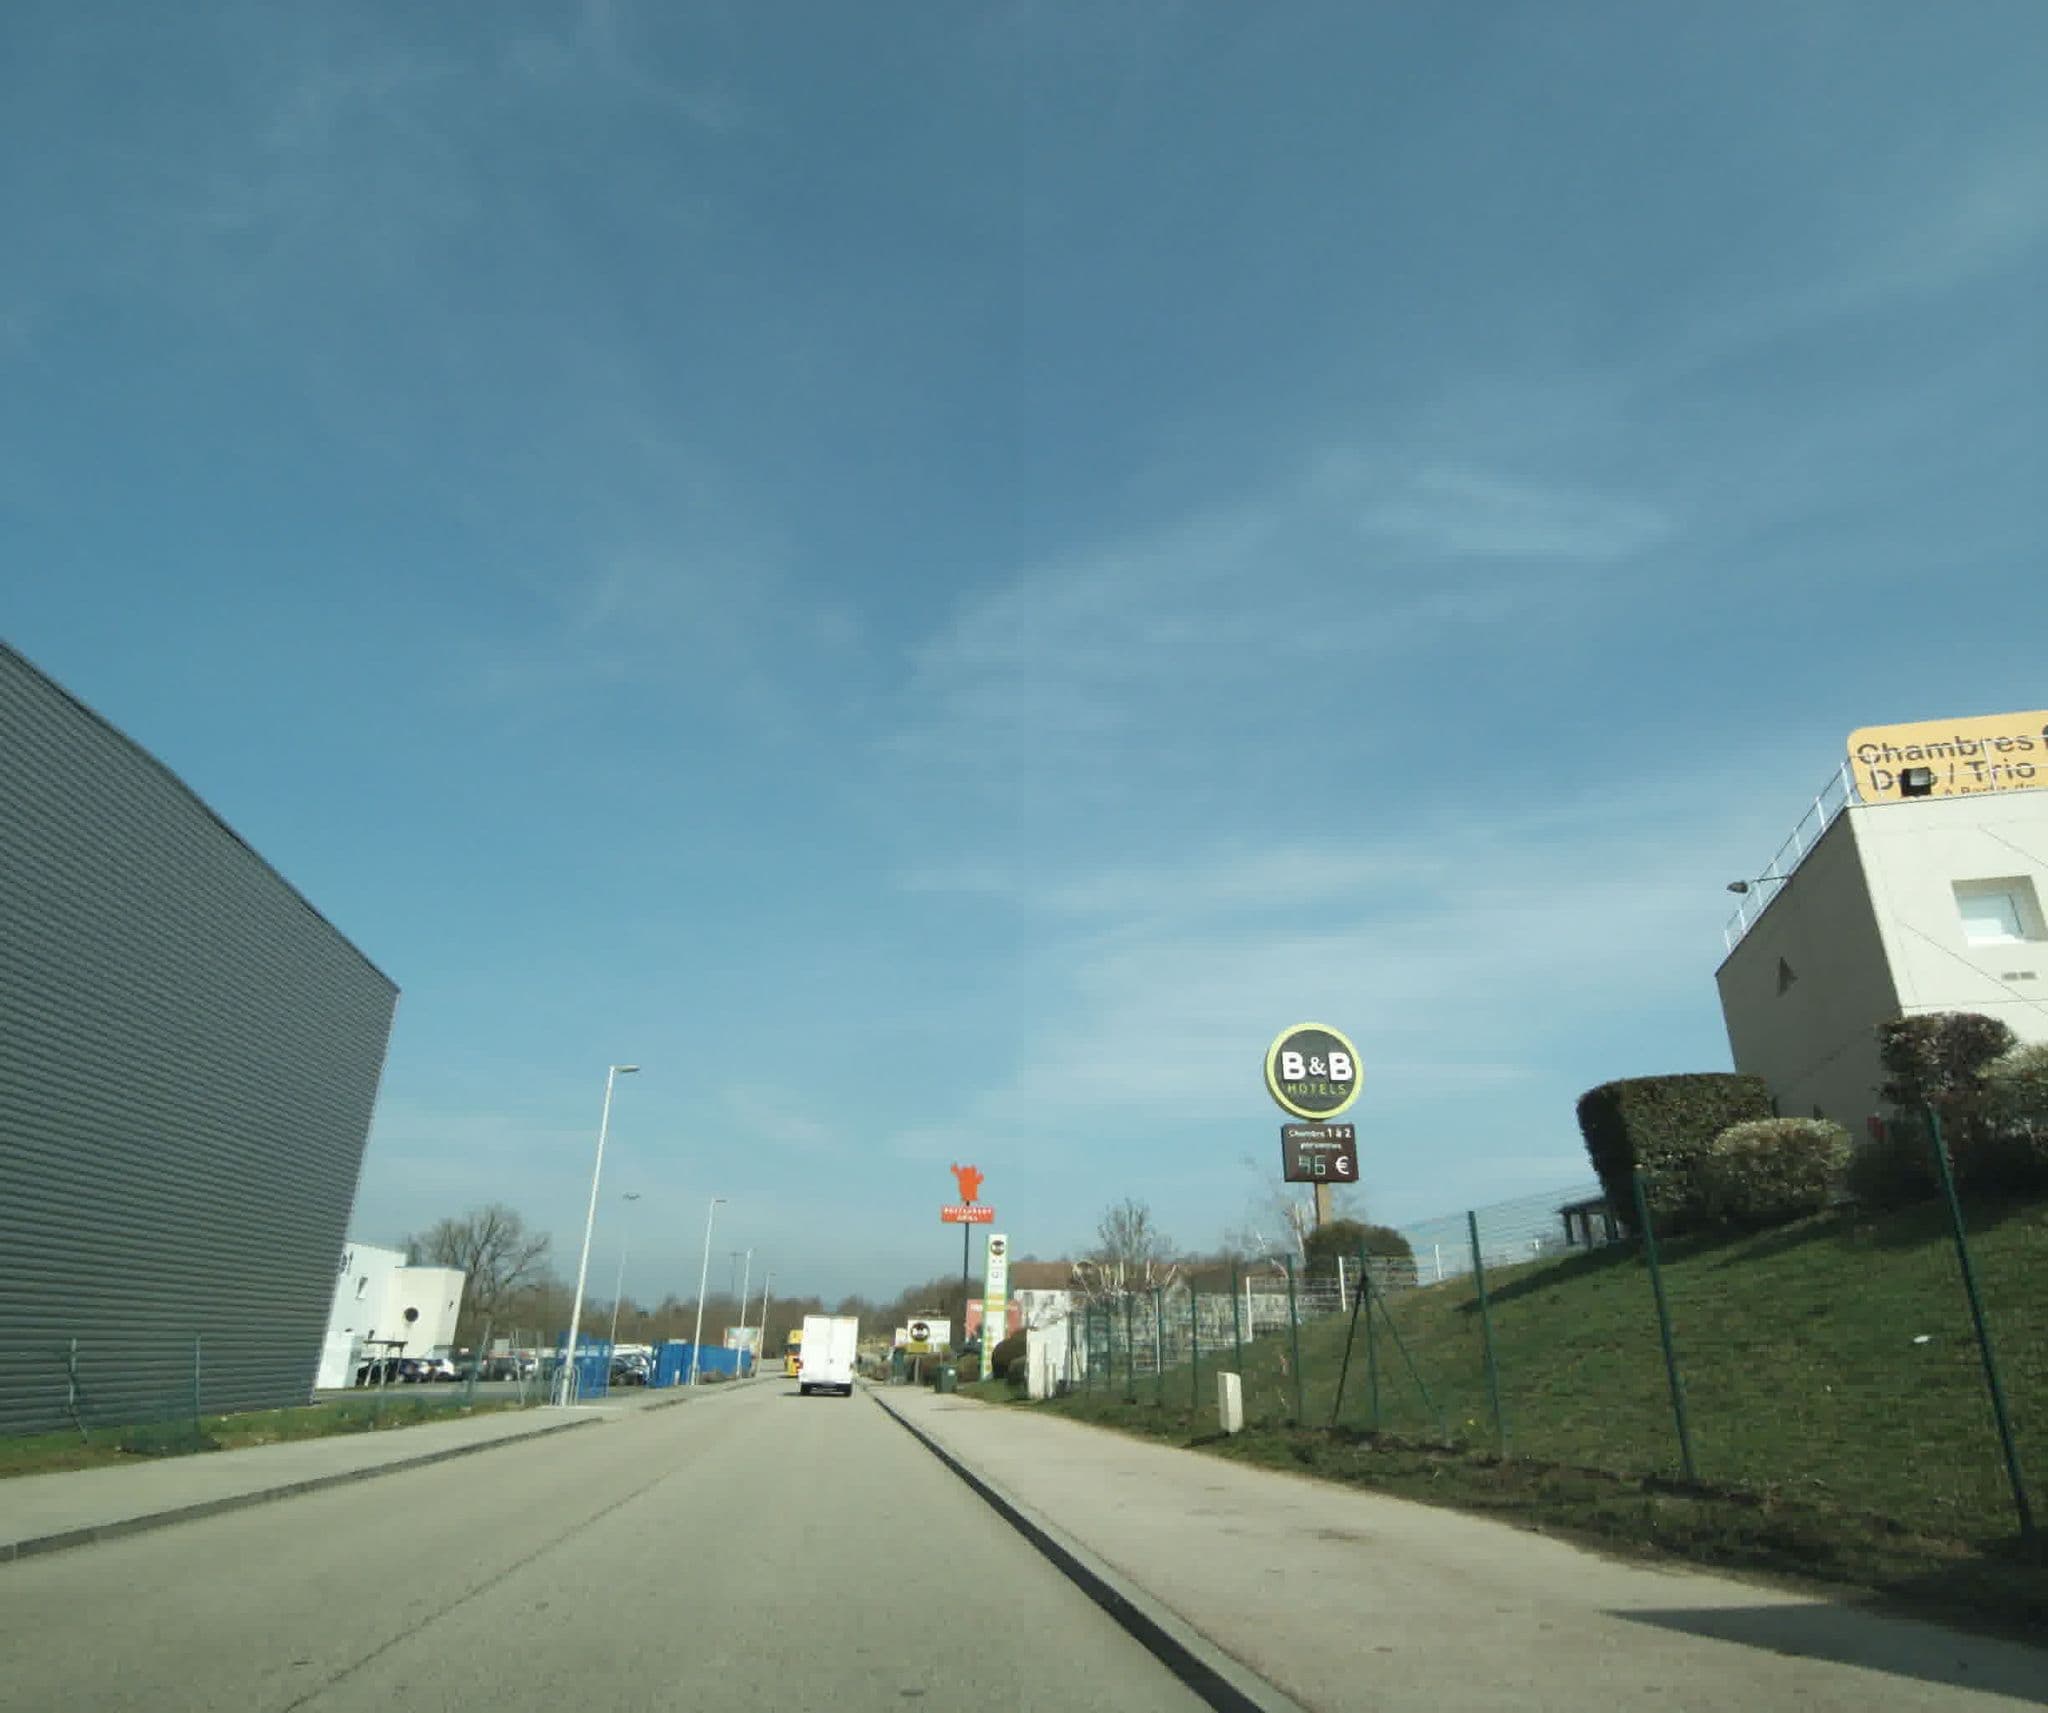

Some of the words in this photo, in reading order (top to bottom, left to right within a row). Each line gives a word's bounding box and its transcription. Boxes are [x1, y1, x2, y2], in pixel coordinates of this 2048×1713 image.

[1857, 735, 2035, 765] Chambres
[1966, 757, 2036, 782] Trio
[1281, 1051, 1353, 1081] B&B
[1287, 1083, 1347, 1095] HOTELS
